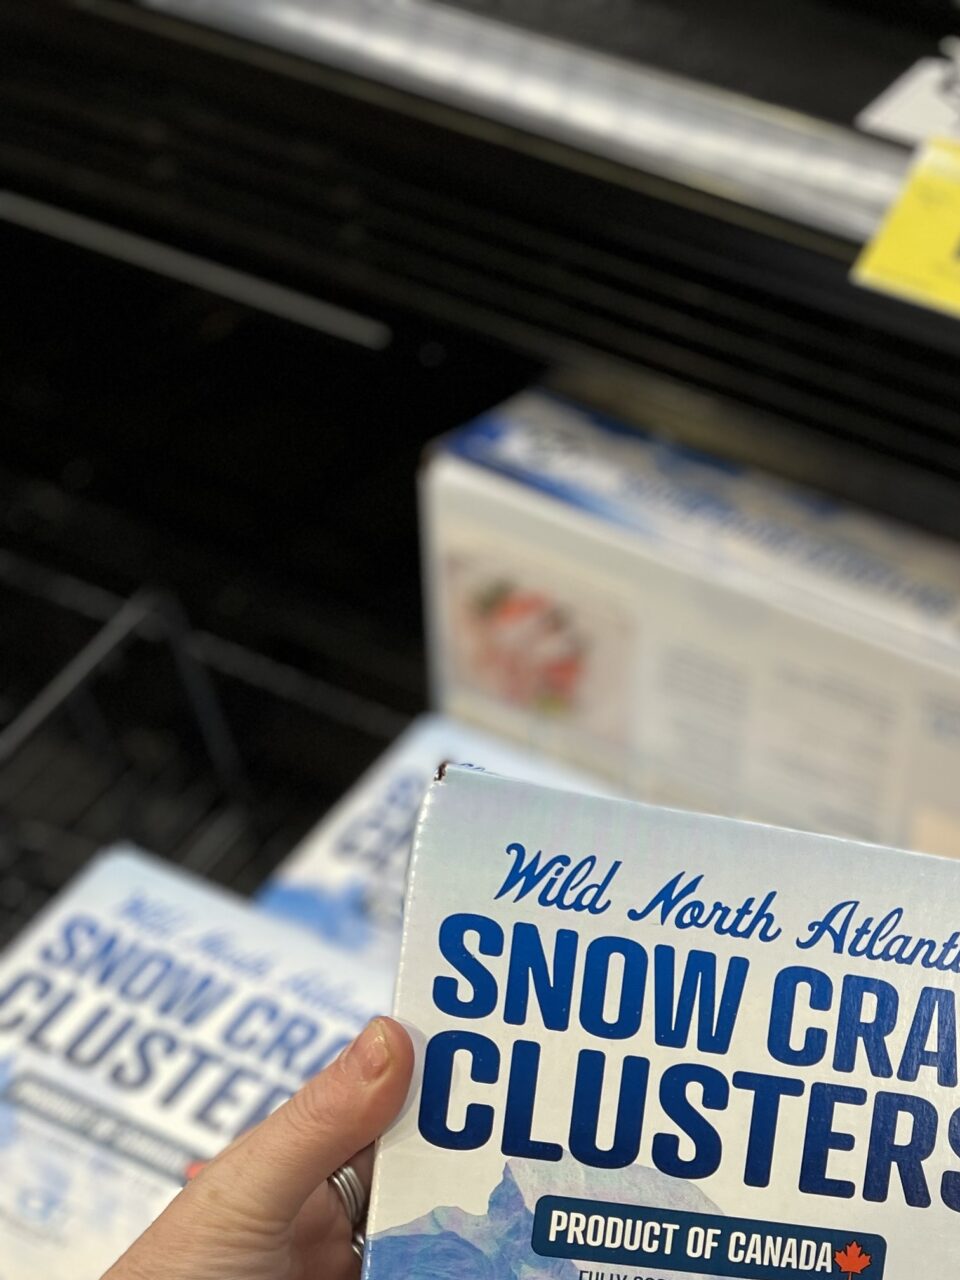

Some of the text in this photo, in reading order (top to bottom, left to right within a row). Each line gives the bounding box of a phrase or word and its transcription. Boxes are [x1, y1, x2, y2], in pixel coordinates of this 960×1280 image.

[495, 843, 622, 915] Wild
[628, 871, 781, 943] North
[38, 913, 235, 1028] SNOW
[432, 912, 750, 1055] SNOW
[548, 1210, 833, 1273] PRODUCT OF CANADA
